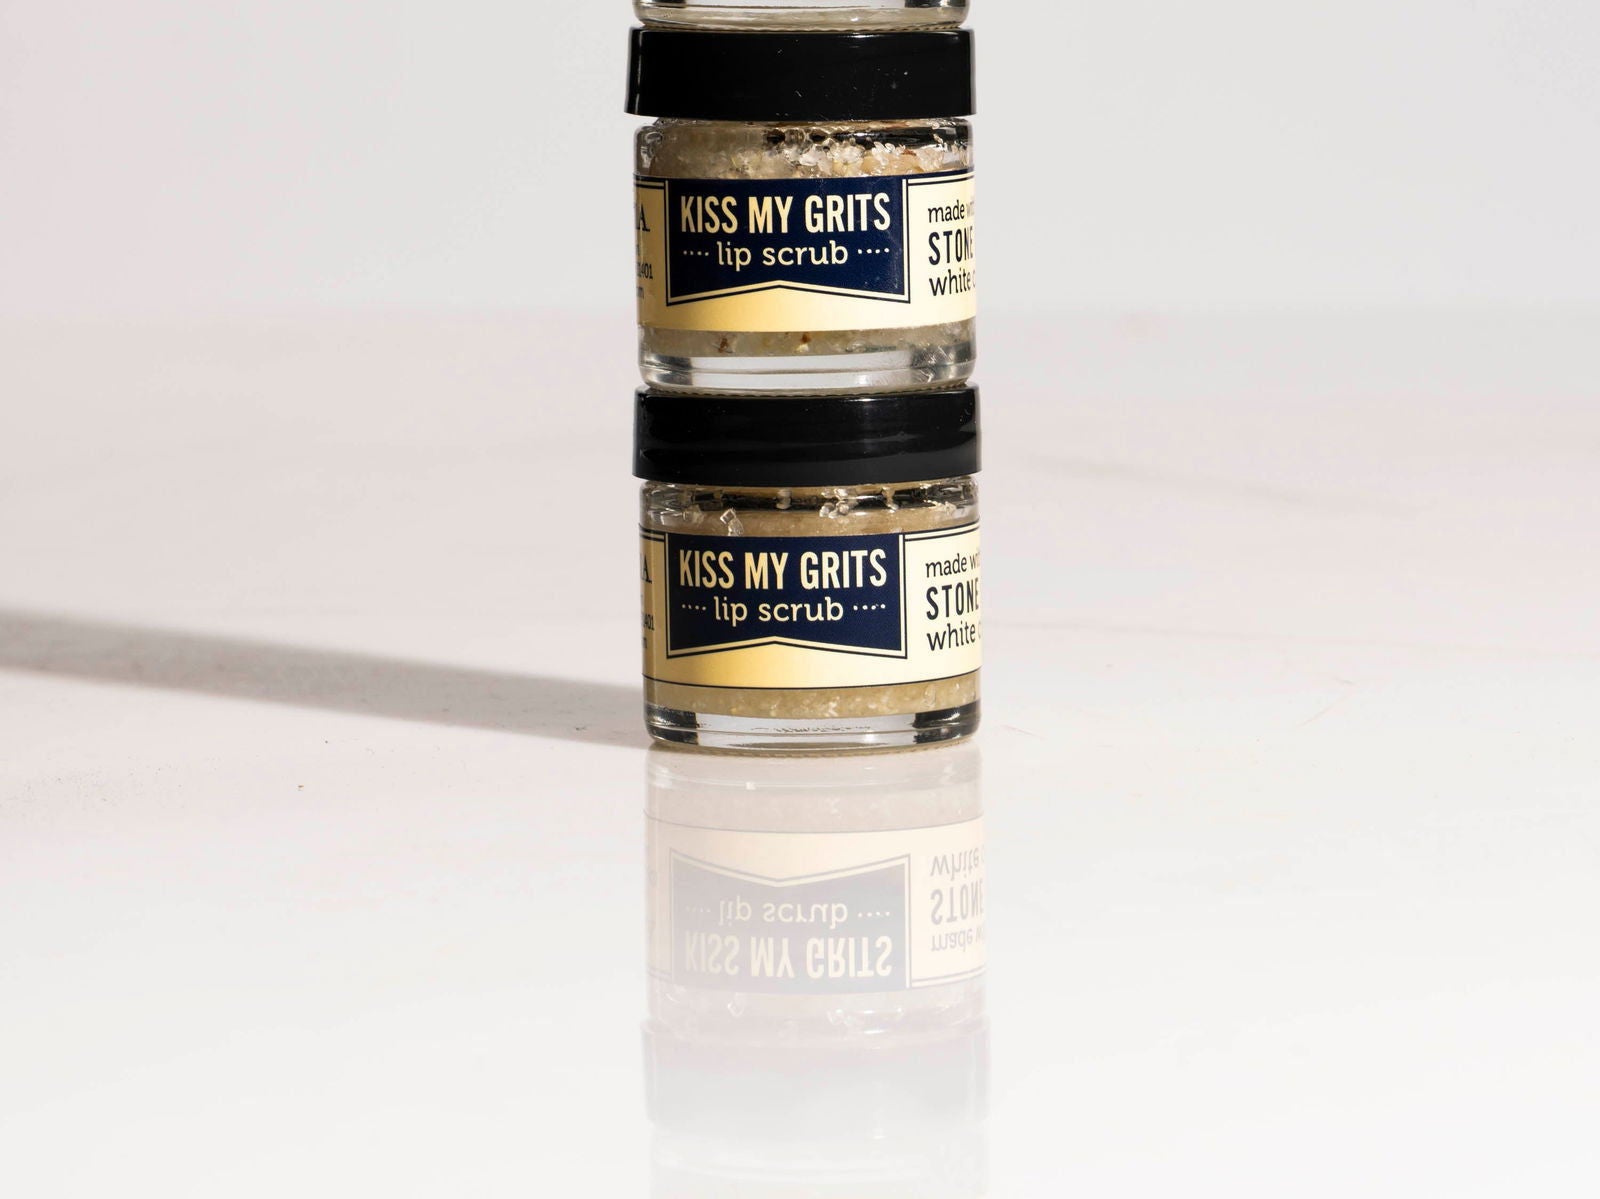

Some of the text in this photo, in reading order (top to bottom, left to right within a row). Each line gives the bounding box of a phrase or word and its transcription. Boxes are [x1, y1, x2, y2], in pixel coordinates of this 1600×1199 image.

[680, 192, 891, 234] KISS MY GRITS
[927, 199, 965, 224] made
[716, 240, 848, 271] lip scrub
[929, 266, 971, 297] white
[679, 548, 887, 590] KISS MY GRITS
[925, 552, 968, 579] made
[714, 596, 844, 627] lip scrub
[926, 577, 979, 621] STONE
[926, 620, 976, 652] white
